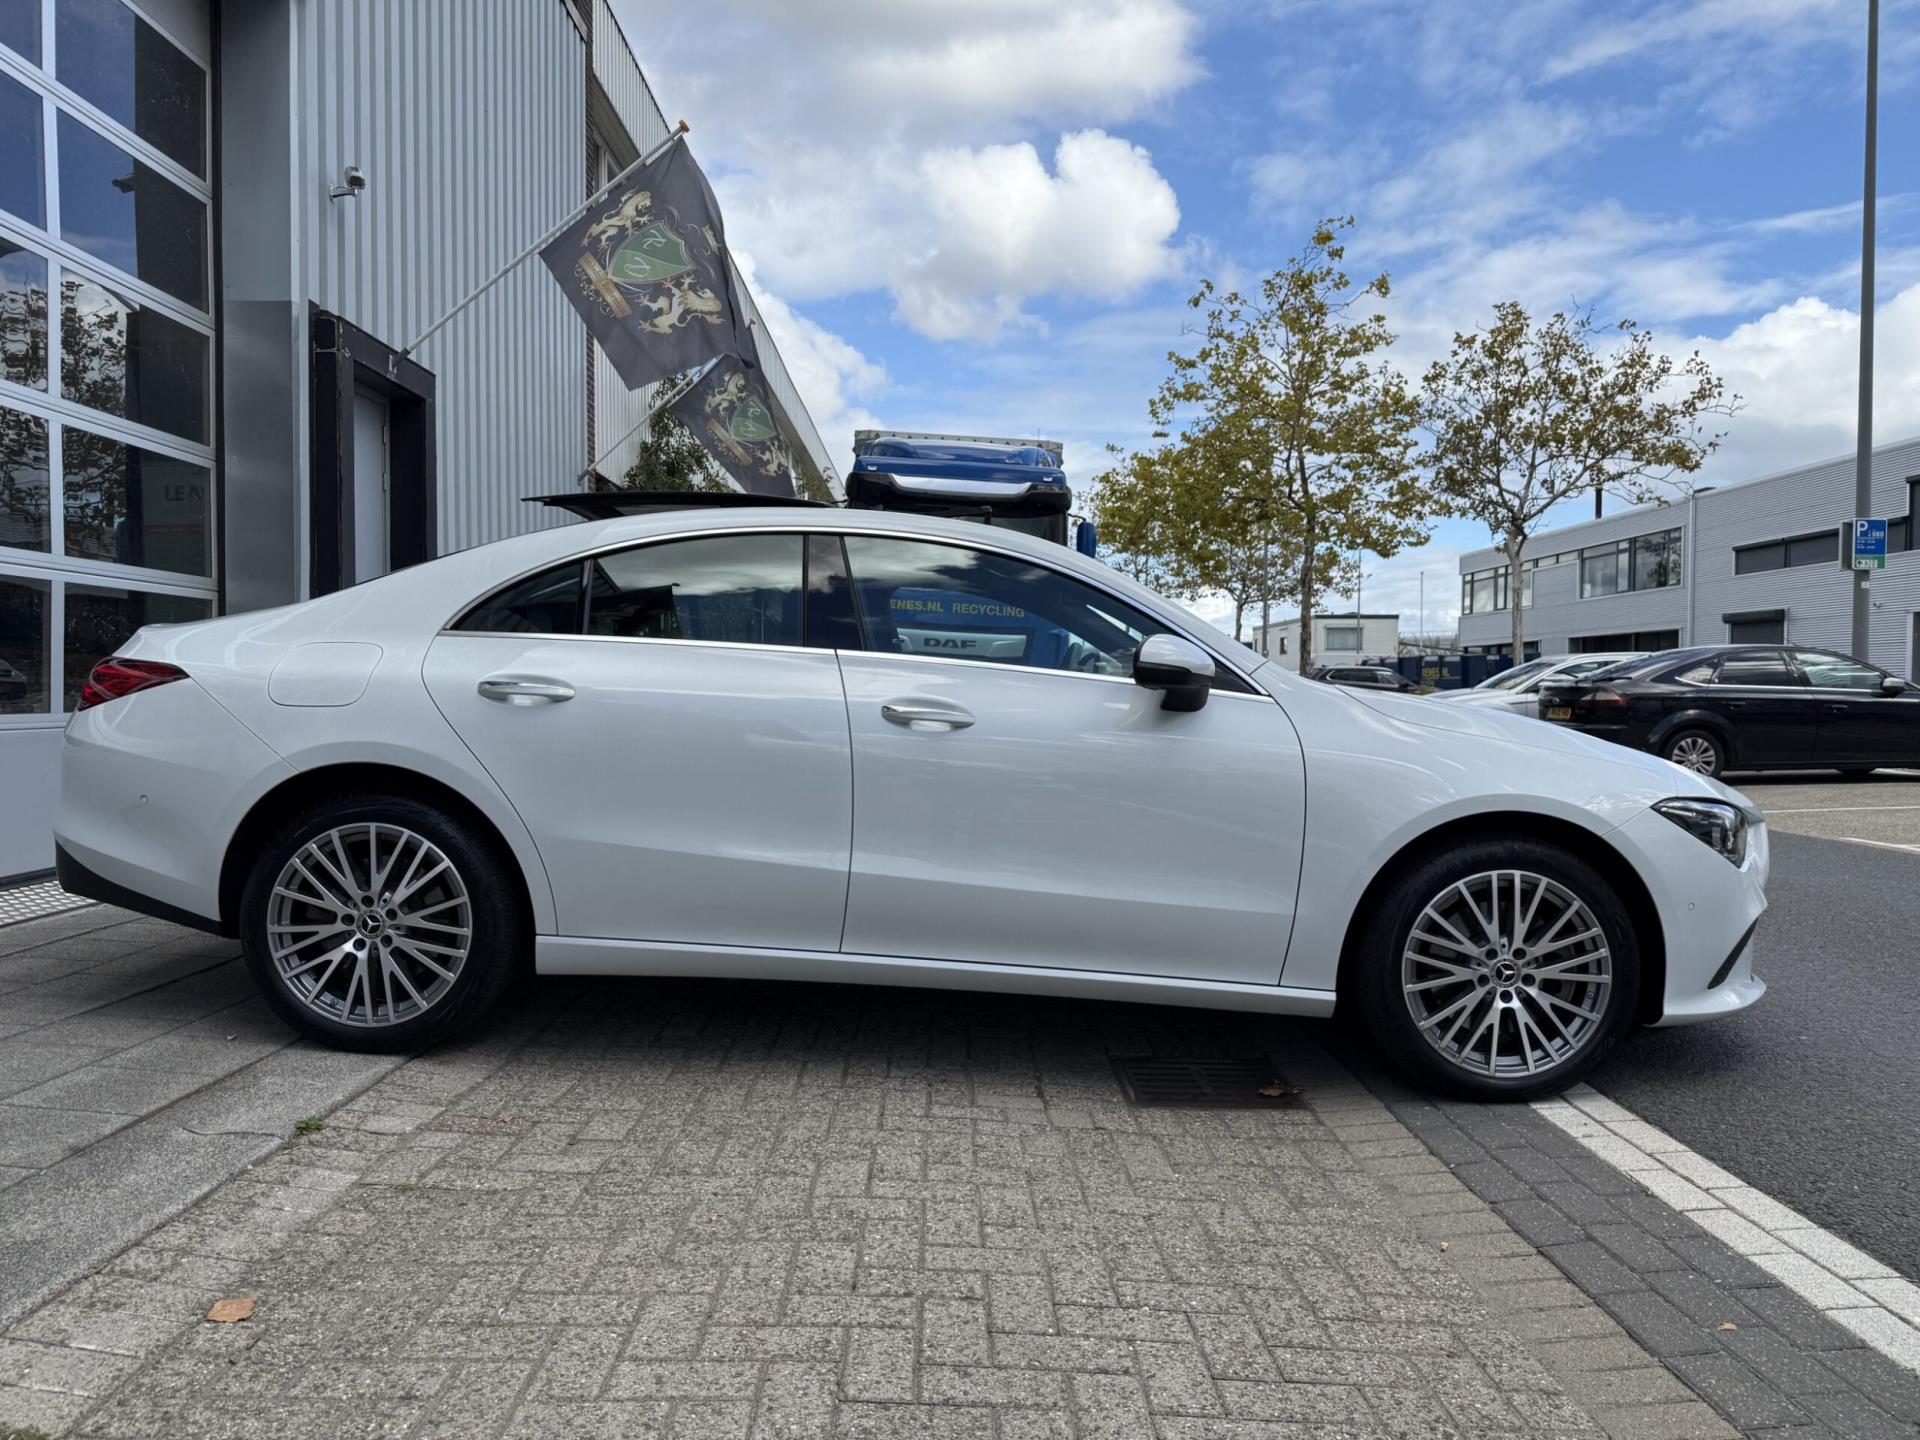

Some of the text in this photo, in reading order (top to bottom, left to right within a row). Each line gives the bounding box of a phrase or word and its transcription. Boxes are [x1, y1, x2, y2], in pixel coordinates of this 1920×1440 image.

[1857, 520, 1868, 537] P
[952, 602, 1025, 618] RECYCLING
[923, 637, 977, 649] DAF
